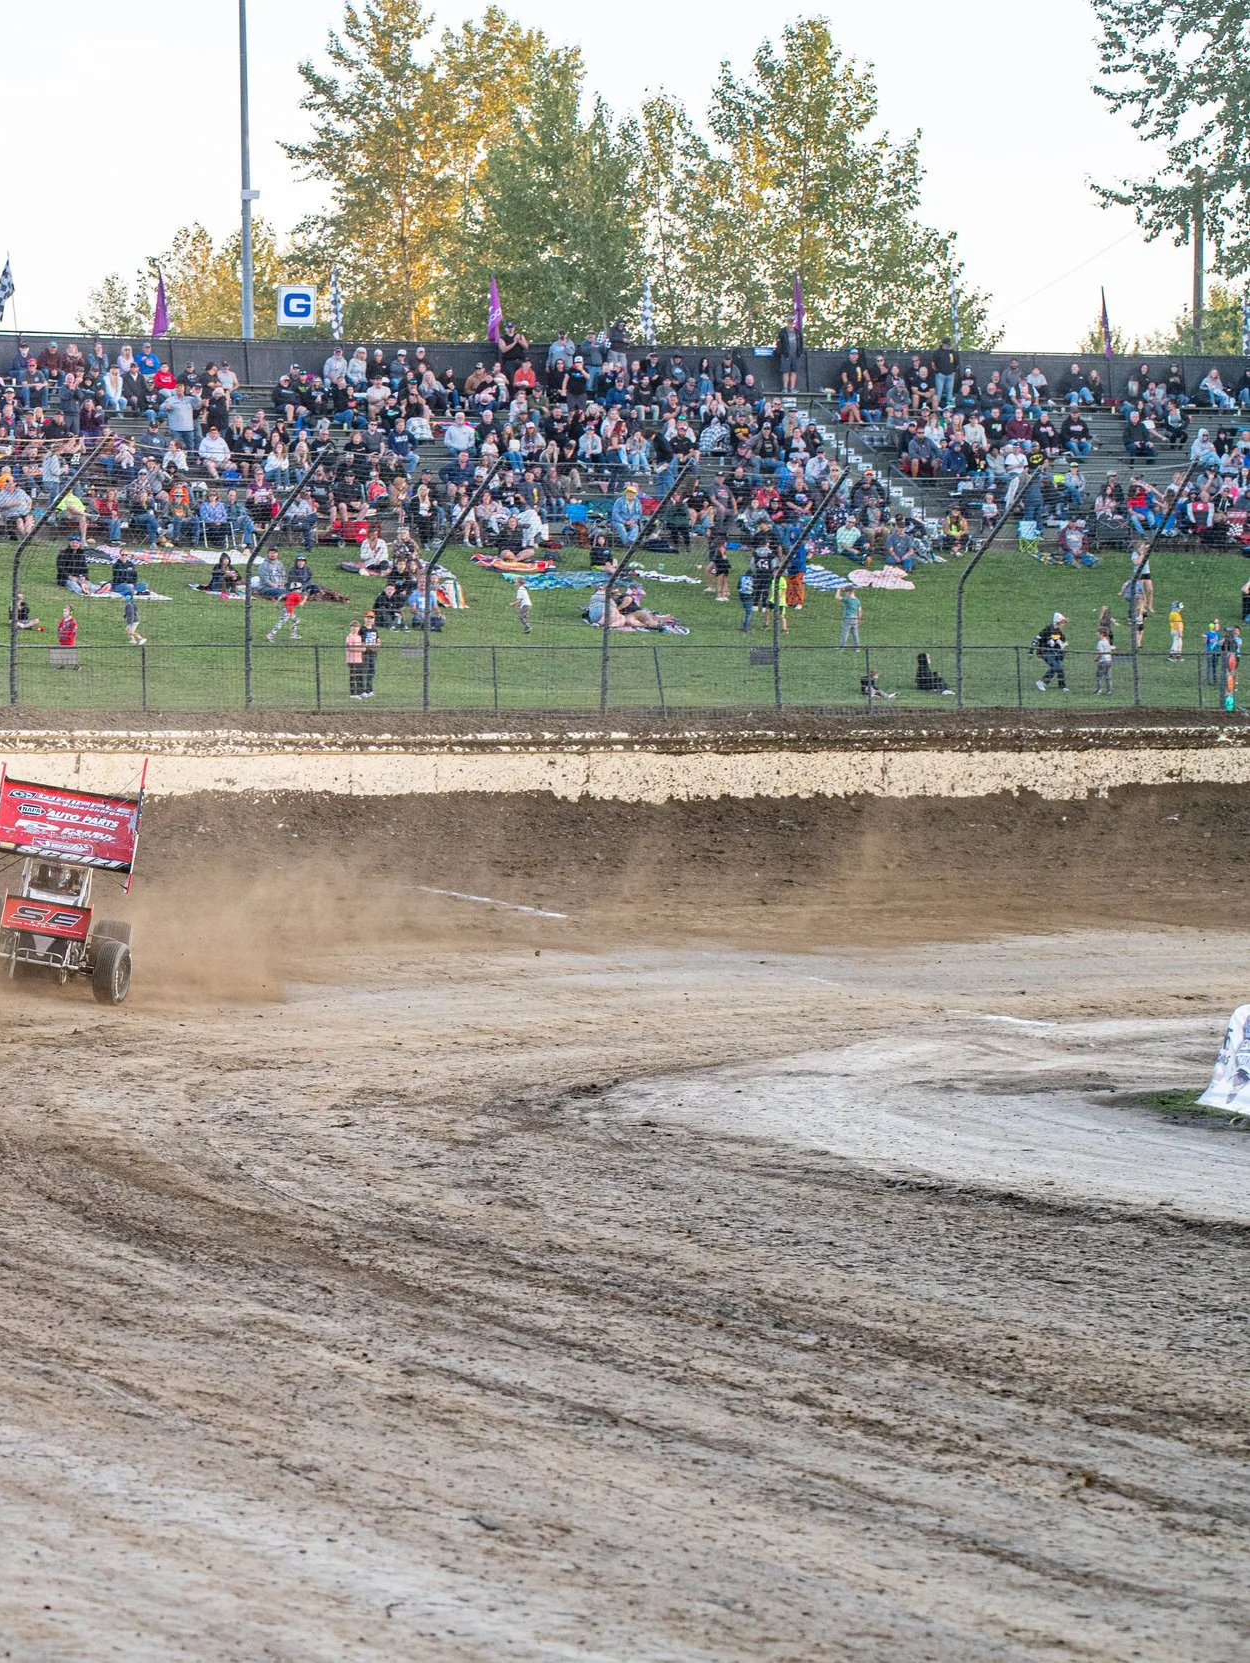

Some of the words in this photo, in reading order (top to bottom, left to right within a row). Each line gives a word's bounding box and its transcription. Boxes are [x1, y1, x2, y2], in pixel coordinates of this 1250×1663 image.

[283, 293, 311, 317] G
[22, 806, 41, 814] NAPA
[46, 808, 80, 821] AUTO
[82, 816, 120, 828] PARTS
